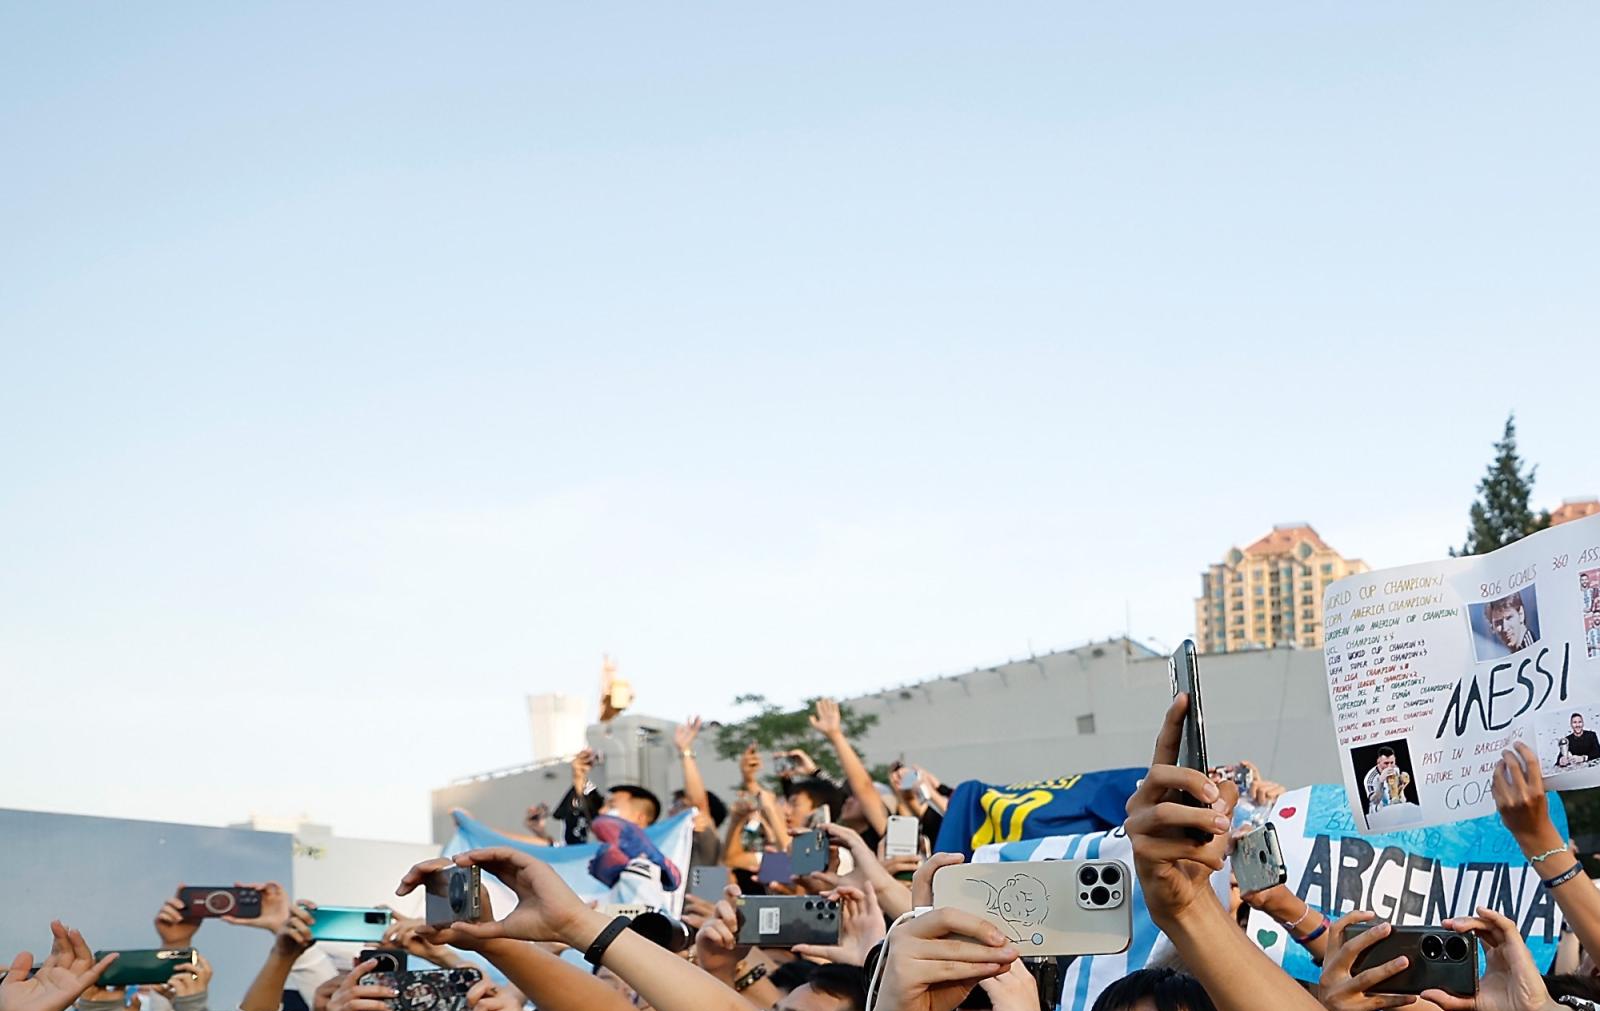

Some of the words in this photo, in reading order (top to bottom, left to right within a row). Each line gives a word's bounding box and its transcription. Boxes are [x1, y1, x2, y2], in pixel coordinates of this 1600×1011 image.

[1551, 553, 1569, 571] 360
[1480, 579, 1502, 598] 806
[1507, 563, 1537, 590] GOALS
[1359, 584, 1377, 600] CUP
[1435, 641, 1571, 740] MESSI
[1422, 750, 1444, 766] PAST
[1451, 748, 1464, 761] IN
[1425, 769, 1454, 785] FUTURE
[1461, 766, 1472, 778] IN
[1295, 833, 1558, 945] ARGENTINA
